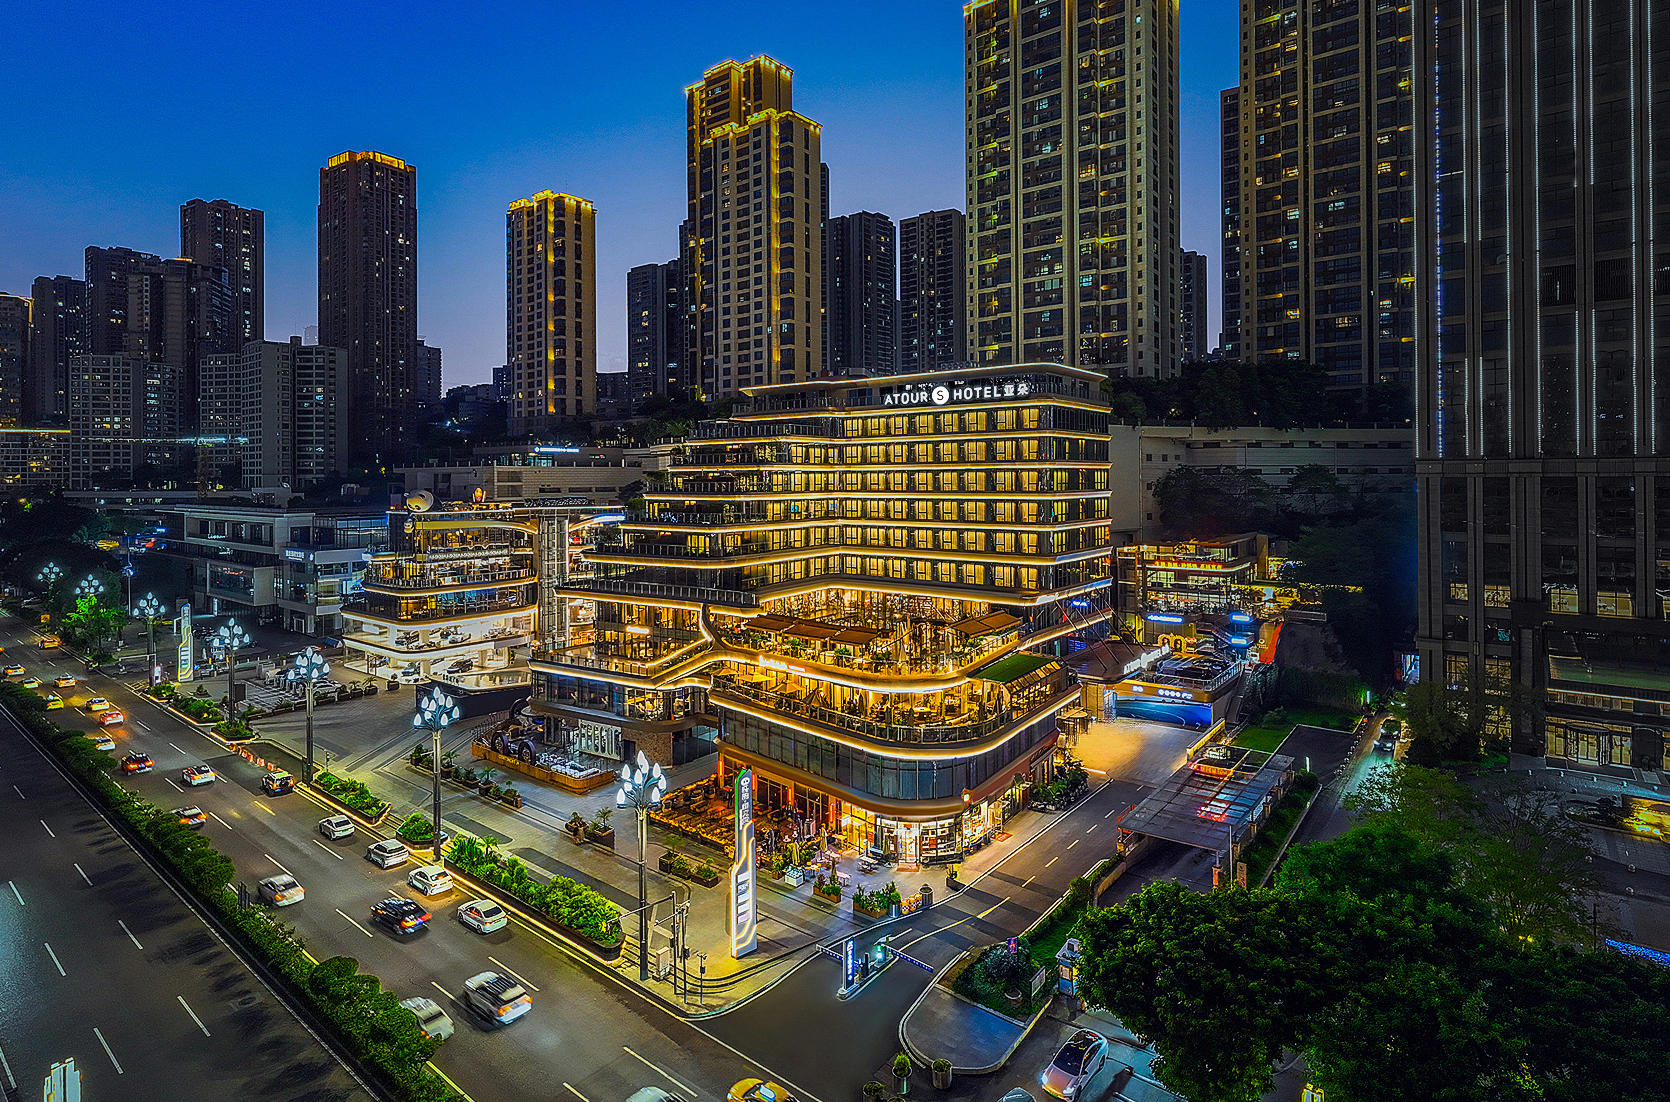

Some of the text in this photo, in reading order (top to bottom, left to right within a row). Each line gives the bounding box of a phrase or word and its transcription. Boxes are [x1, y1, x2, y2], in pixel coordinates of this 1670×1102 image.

[884, 391, 928, 406] ATOUR
[953, 385, 1001, 400] HOTEL
[1003, 382, 1031, 397] 亚朵
